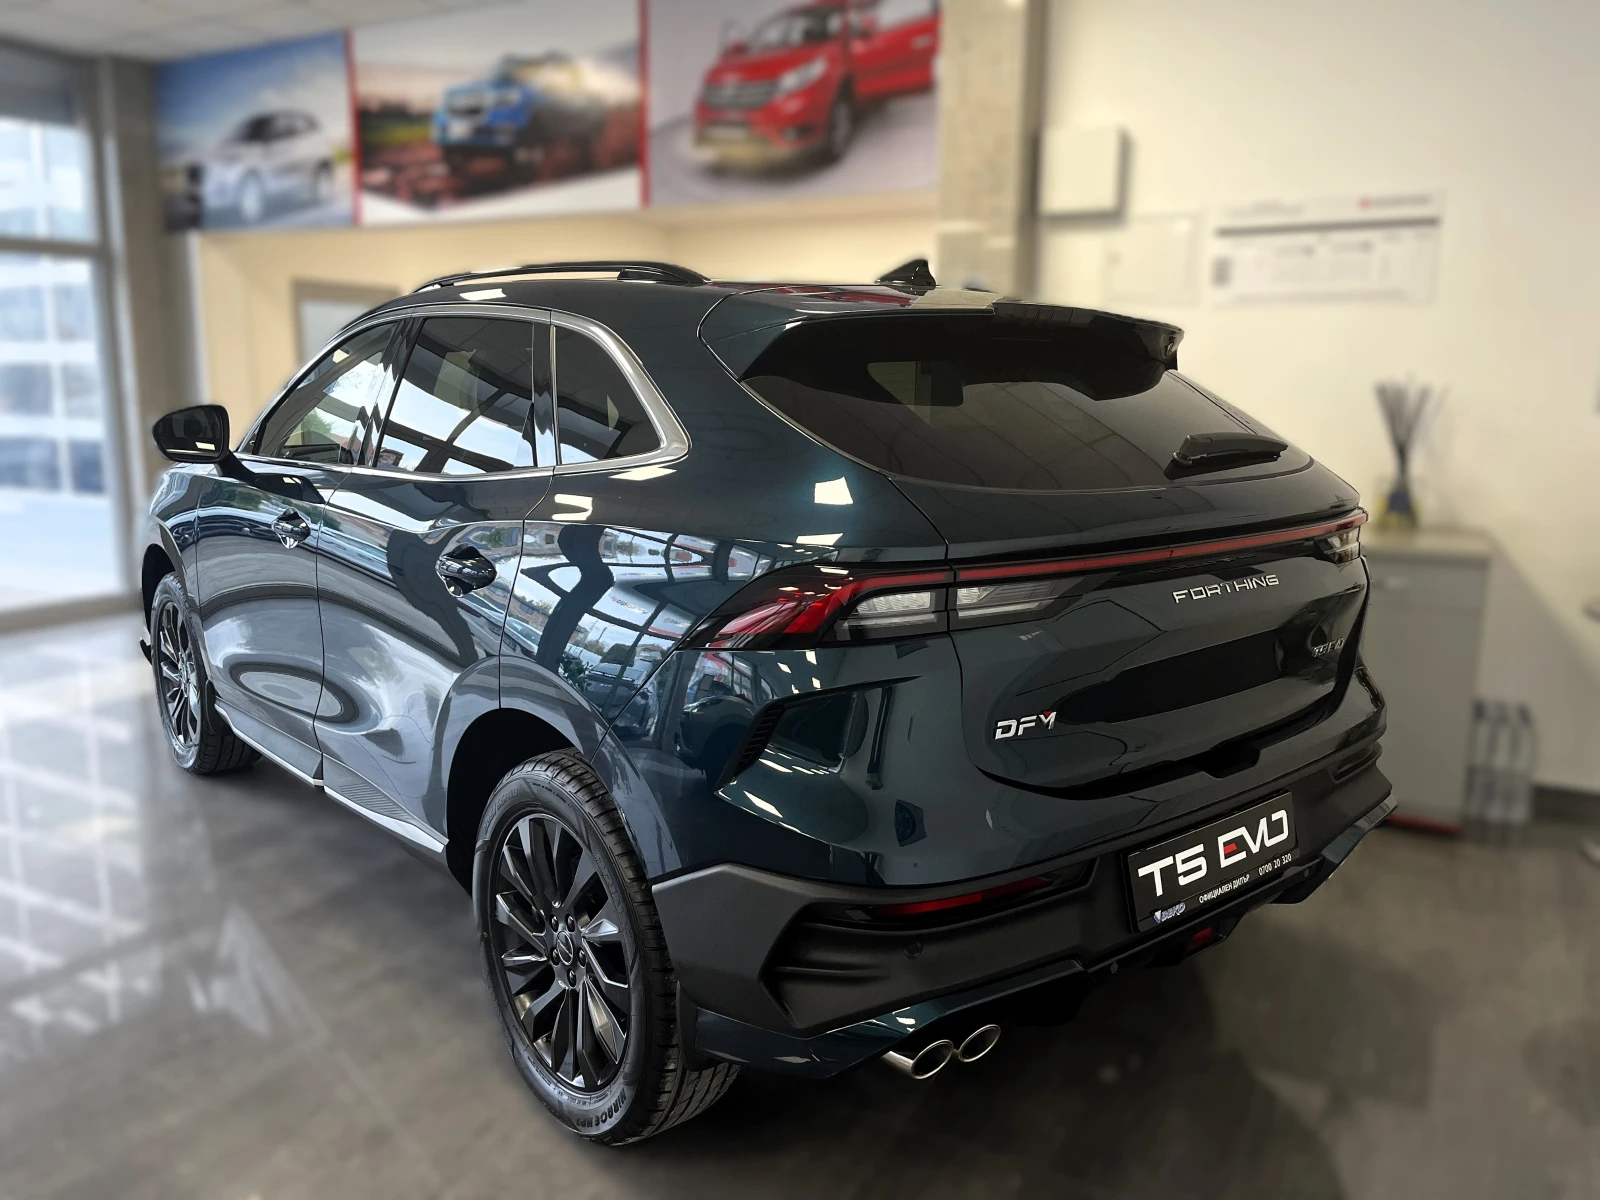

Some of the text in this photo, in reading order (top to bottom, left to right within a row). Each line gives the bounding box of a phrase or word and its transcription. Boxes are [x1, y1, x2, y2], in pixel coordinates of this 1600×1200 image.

[1172, 574, 1280, 603] FORTHING
[994, 711, 1057, 740] DFM
[1137, 809, 1289, 897] T5 EVO
[1199, 883, 1233, 903] ОФИЦИАЛЕН
[1258, 862, 1273, 876] 0700
